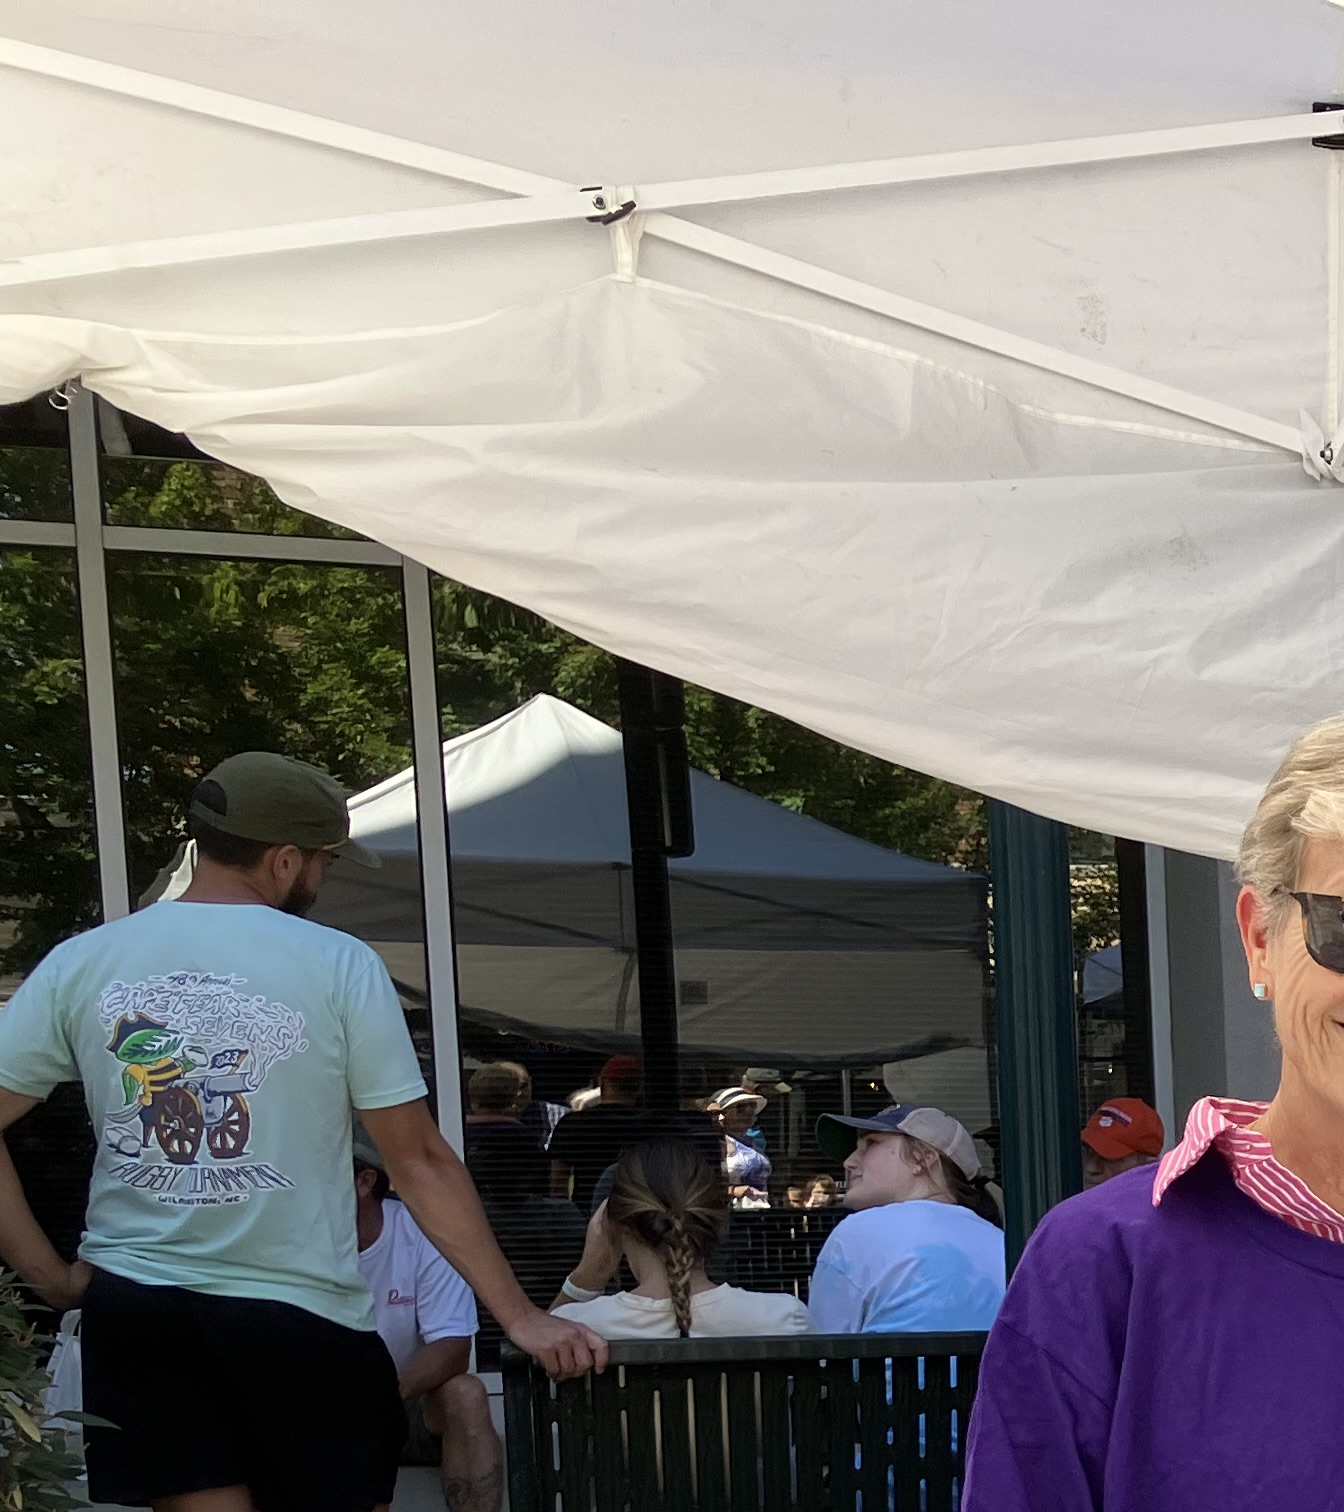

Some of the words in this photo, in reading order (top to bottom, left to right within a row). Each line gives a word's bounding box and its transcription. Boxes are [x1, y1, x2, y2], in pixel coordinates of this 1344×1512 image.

[100, 986, 172, 1016] CAPE
[173, 993, 240, 1018] FEAR
[179, 1016, 294, 1050] SEVENS
[109, 1162, 184, 1191] RUGBY
